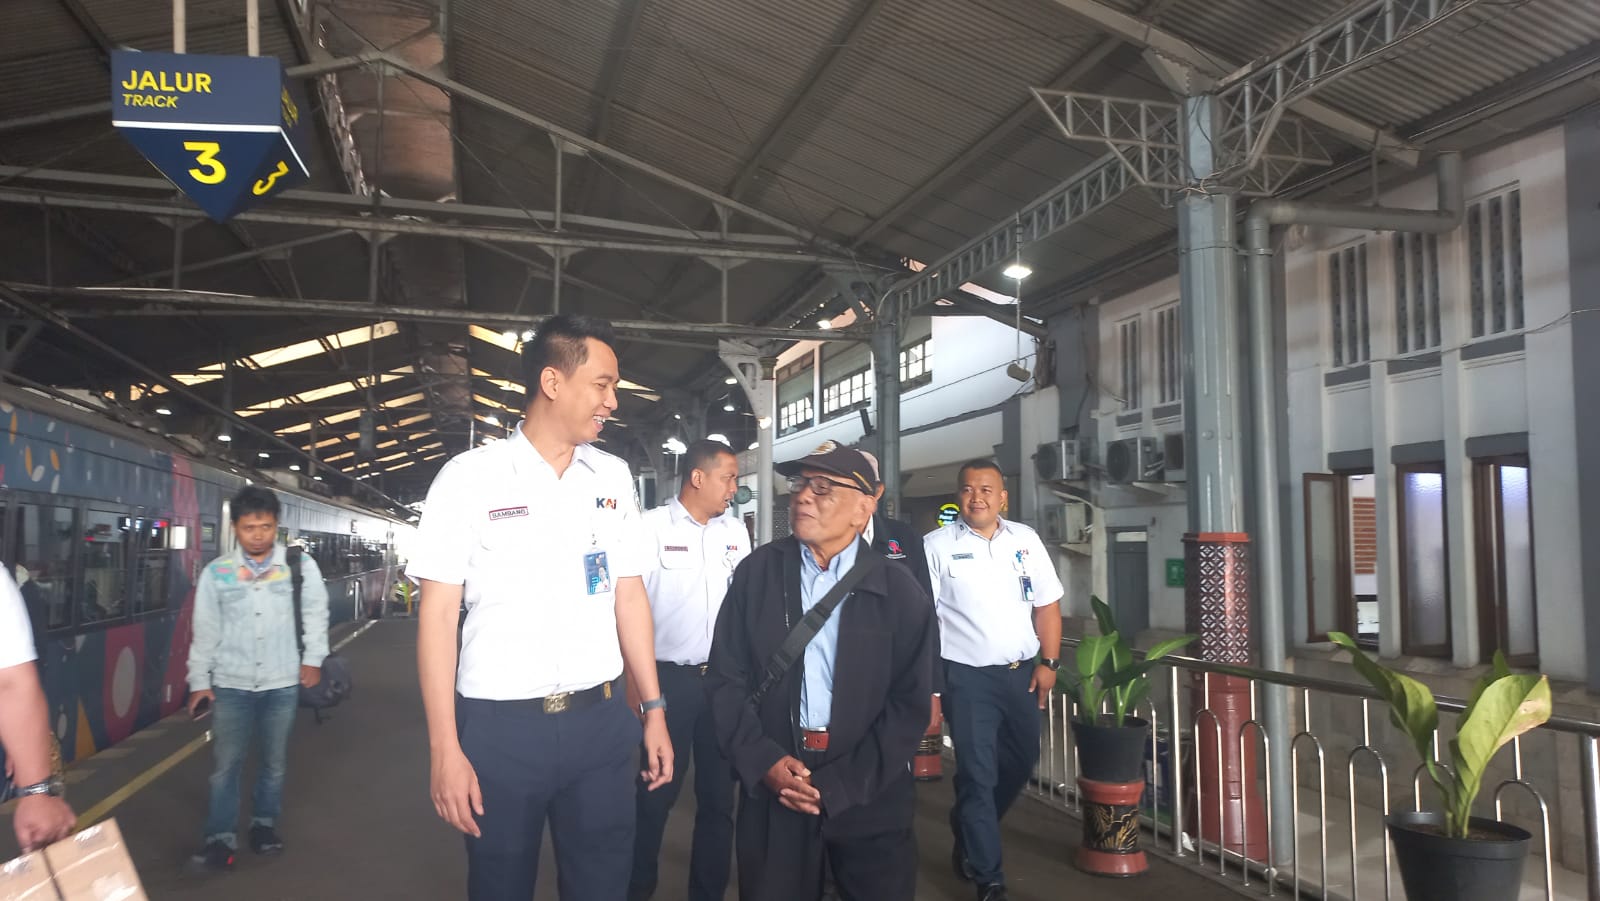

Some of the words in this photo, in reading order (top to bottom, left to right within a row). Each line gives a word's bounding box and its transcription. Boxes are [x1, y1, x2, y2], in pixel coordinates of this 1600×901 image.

[121, 69, 213, 94] JALUR
[122, 93, 180, 109] TRACK
[183, 141, 228, 185] 3
[252, 160, 290, 196] 3
[491, 508, 526, 519] BAMBANG
